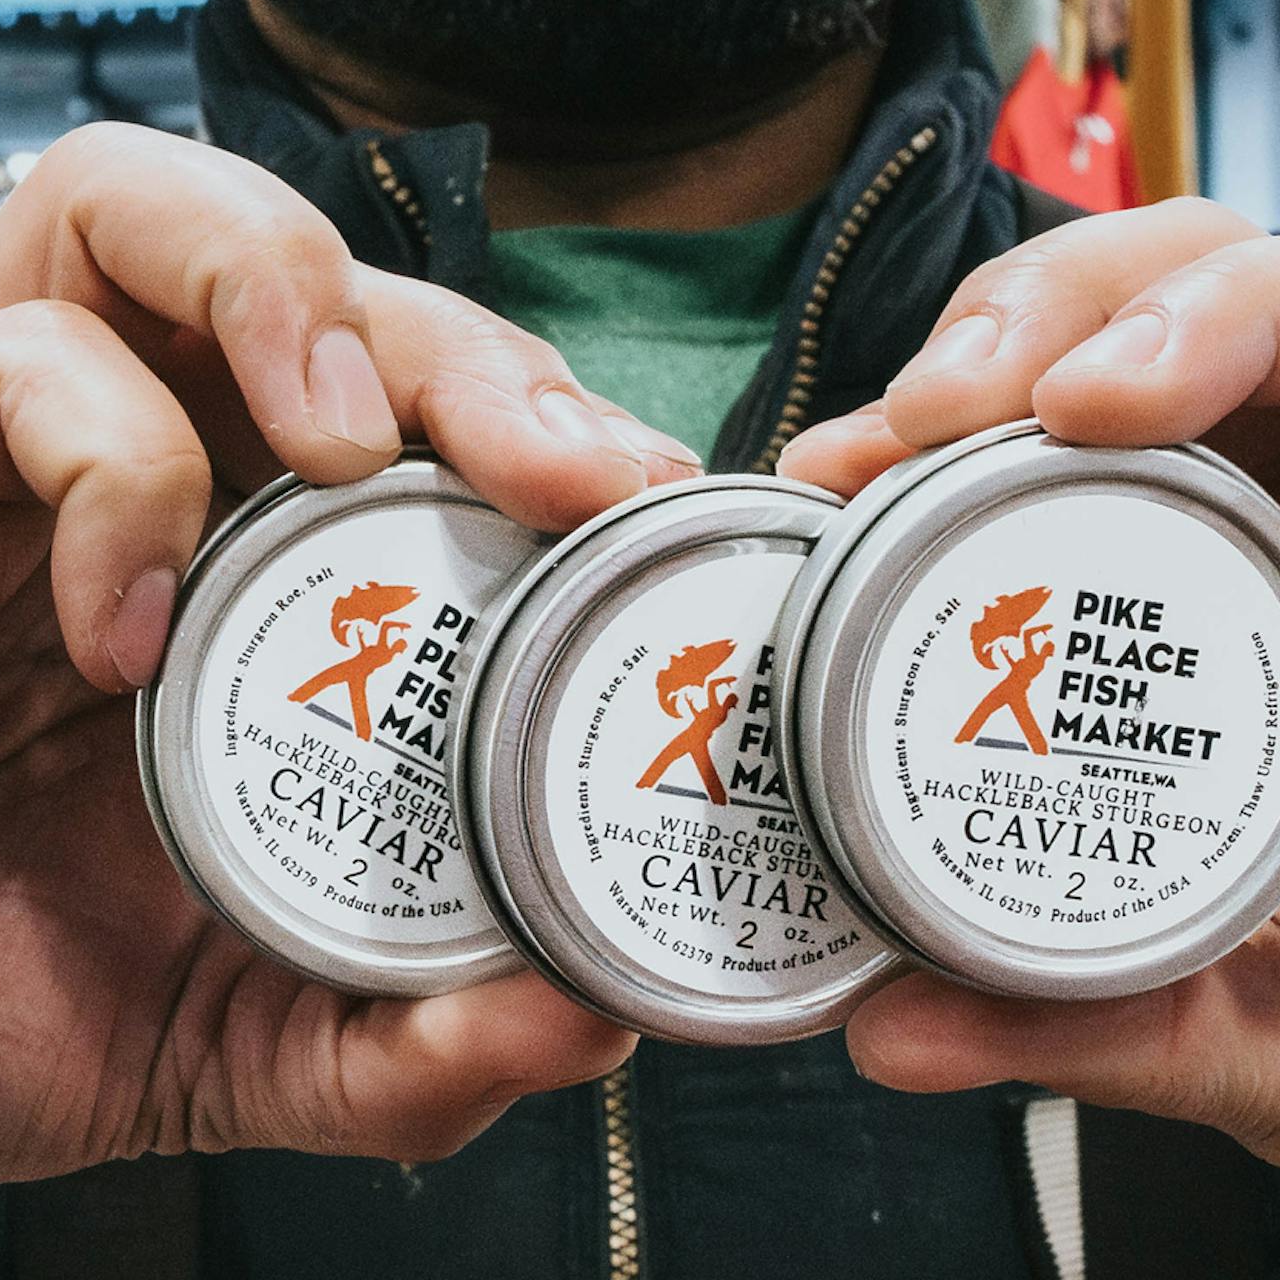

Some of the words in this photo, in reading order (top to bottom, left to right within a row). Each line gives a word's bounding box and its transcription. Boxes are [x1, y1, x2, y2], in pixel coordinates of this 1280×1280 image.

[237, 611, 278, 667] Sturgeon
[306, 566, 334, 588] Salt
[433, 603, 476, 644] PI
[1073, 589, 1165, 633] PIKE
[894, 662, 921, 727] Sturgeon
[935, 597, 962, 625] Salt
[1064, 630, 1200, 679] PLACE
[1250, 631, 1280, 729] Refrigeration
[395, 670, 452, 720] FIS
[578, 705, 606, 769] Sturgeon
[622, 644, 650, 671] Salt
[1058, 670, 1150, 712] FISH
[738, 722, 771, 757] FI
[1051, 708, 1222, 761] MARKET
[1257, 734, 1278, 777] Under
[243, 724, 388, 810] HACKLEBACK
[391, 803, 462, 852] STURG
[922, 779, 1082, 817] HACKLEBACK
[1091, 802, 1222, 837] STURGEON
[980, 768, 1157, 809] WILD-CAUGHT
[1238, 781, 1265, 819] Thaw
[234, 780, 265, 841] Warsaw,
[264, 837, 278, 858] IL
[280, 855, 318, 888] 62379
[322, 884, 376, 915] Product
[381, 903, 403, 918] of
[401, 904, 425, 918] the
[430, 898, 465, 917] USA
[260, 804, 298, 834] Net
[306, 825, 340, 857] Wt.
[343, 858, 369, 887] 2
[391, 877, 421, 900] oz.
[270, 767, 444, 883] CAVIAR
[603, 822, 759, 869] HACKLEBACK
[766, 855, 827, 883] STUR
[660, 815, 812, 861] WILD-CAUGH
[963, 808, 1158, 868] CAVIAR
[641, 853, 829, 923] CAVIAR
[930, 837, 976, 893] Warsaw,
[978, 883, 995, 903] IL
[999, 894, 1042, 919] 62379
[1050, 907, 1107, 924] Product
[1112, 903, 1128, 920] of
[1131, 895, 1155, 915] the
[1157, 874, 1192, 902] USA
[964, 850, 1005, 872] Net
[1015, 857, 1054, 879] Wt.
[1064, 871, 1087, 901] 2
[1113, 875, 1146, 892] oz.
[608, 880, 649, 936] Warsaw,
[652, 927, 668, 947] IL
[671, 939, 713, 966] 62379
[721, 955, 776, 973] Product
[781, 948, 801, 970] of
[800, 948, 825, 966] the
[826, 929, 862, 956] USA
[640, 895, 680, 918] Net
[689, 904, 726, 927] Wt.
[735, 920, 758, 950] 2
[784, 926, 817, 946] oz.
